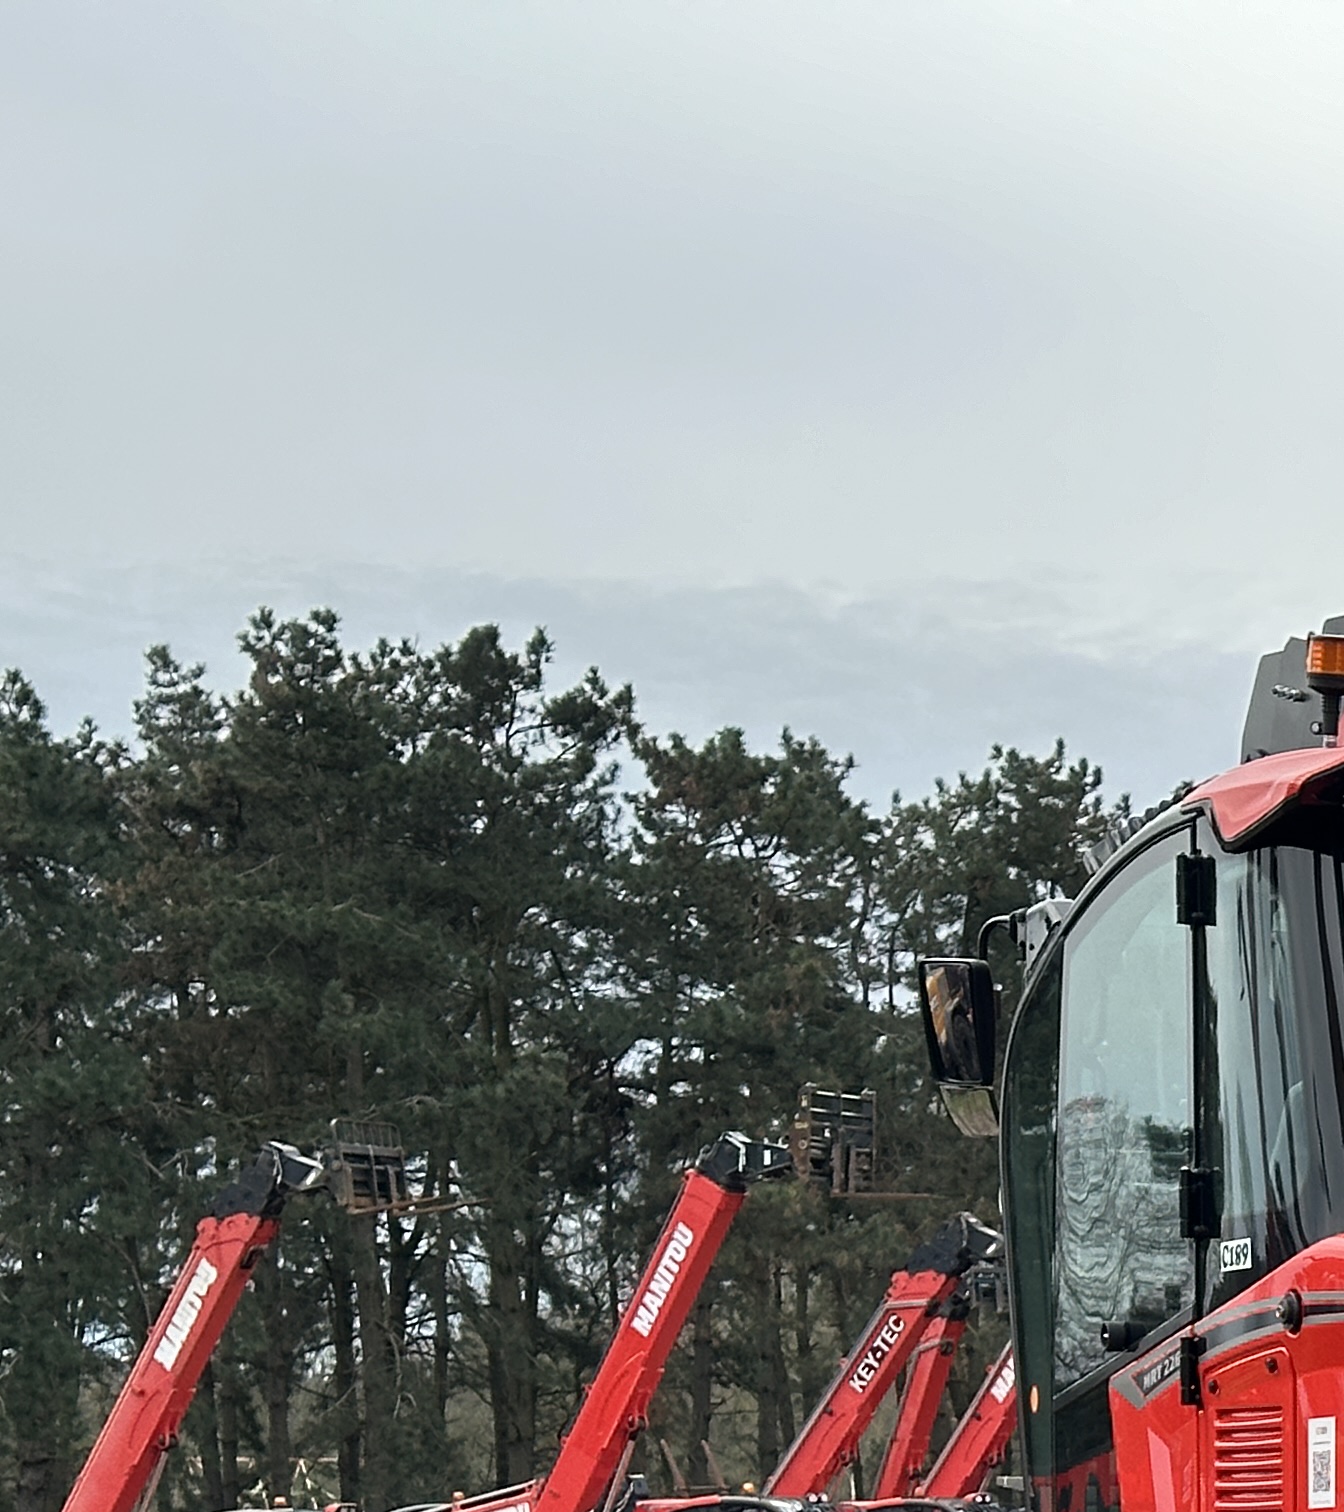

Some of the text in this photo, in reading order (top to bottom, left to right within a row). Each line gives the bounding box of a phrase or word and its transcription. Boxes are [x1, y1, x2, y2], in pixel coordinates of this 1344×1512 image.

[630, 1221, 693, 1338] MANITOU
[1222, 1242, 1249, 1268] C189
[849, 1314, 905, 1393] KEY-TEC
